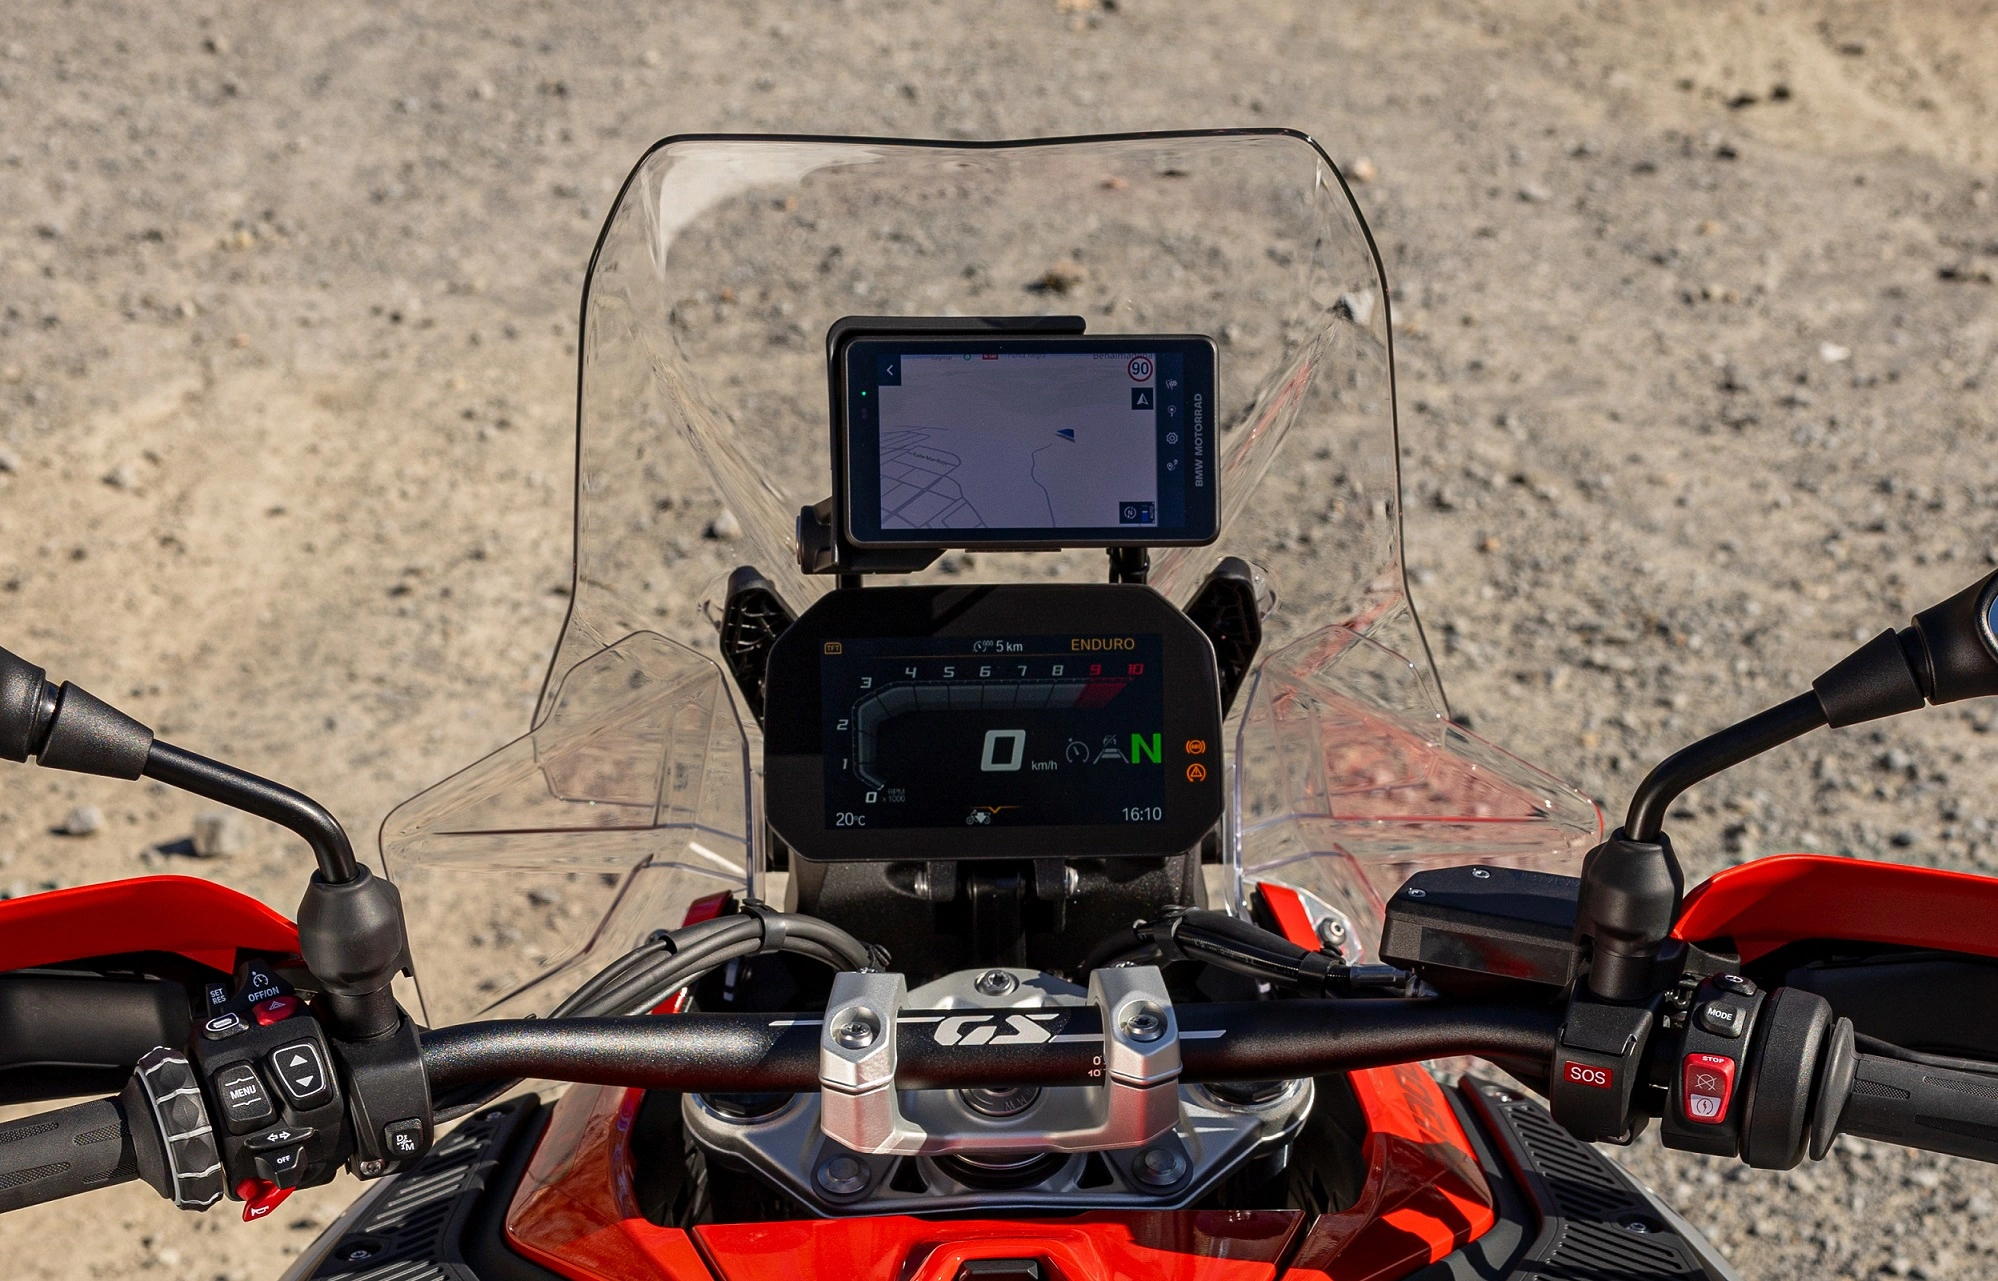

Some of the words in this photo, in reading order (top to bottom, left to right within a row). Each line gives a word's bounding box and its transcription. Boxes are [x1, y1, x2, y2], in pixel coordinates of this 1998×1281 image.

[1131, 362, 1150, 375] 90
[1194, 393, 1203, 456] MOTORRAD
[1195, 459, 1204, 488] BMW
[826, 644, 839, 652] TFT
[996, 639, 1004, 652] 5
[1006, 640, 1023, 652] km
[1071, 638, 1135, 651] ENDURO
[905, 667, 917, 678] 4
[943, 666, 955, 678] 5
[979, 666, 991, 677] 6
[1018, 666, 1027, 676] 7
[1052, 665, 1064, 676] 8
[1090, 664, 1101, 676] 9
[1128, 663, 1144, 675] 10
[860, 677, 872, 688] 3
[837, 719, 849, 730] 2
[980, 729, 1026, 771] 0
[1131, 733, 1162, 764] N
[843, 758, 848, 770] 1
[1031, 760, 1058, 771] km/h
[865, 791, 877, 803] 0
[1122, 806, 1162, 821] 16:10
[209, 988, 223, 998] SET
[248, 986, 280, 1002] OFF/ON
[212, 995, 226, 1005] RES
[1707, 1007, 1733, 1021] MODE
[933, 1013, 1060, 1046] GS
[1702, 1055, 1725, 1064] STOP
[1570, 1066, 1606, 1085] SOS
[229, 1084, 257, 1100] MENU
[276, 1155, 291, 1164] OFF
